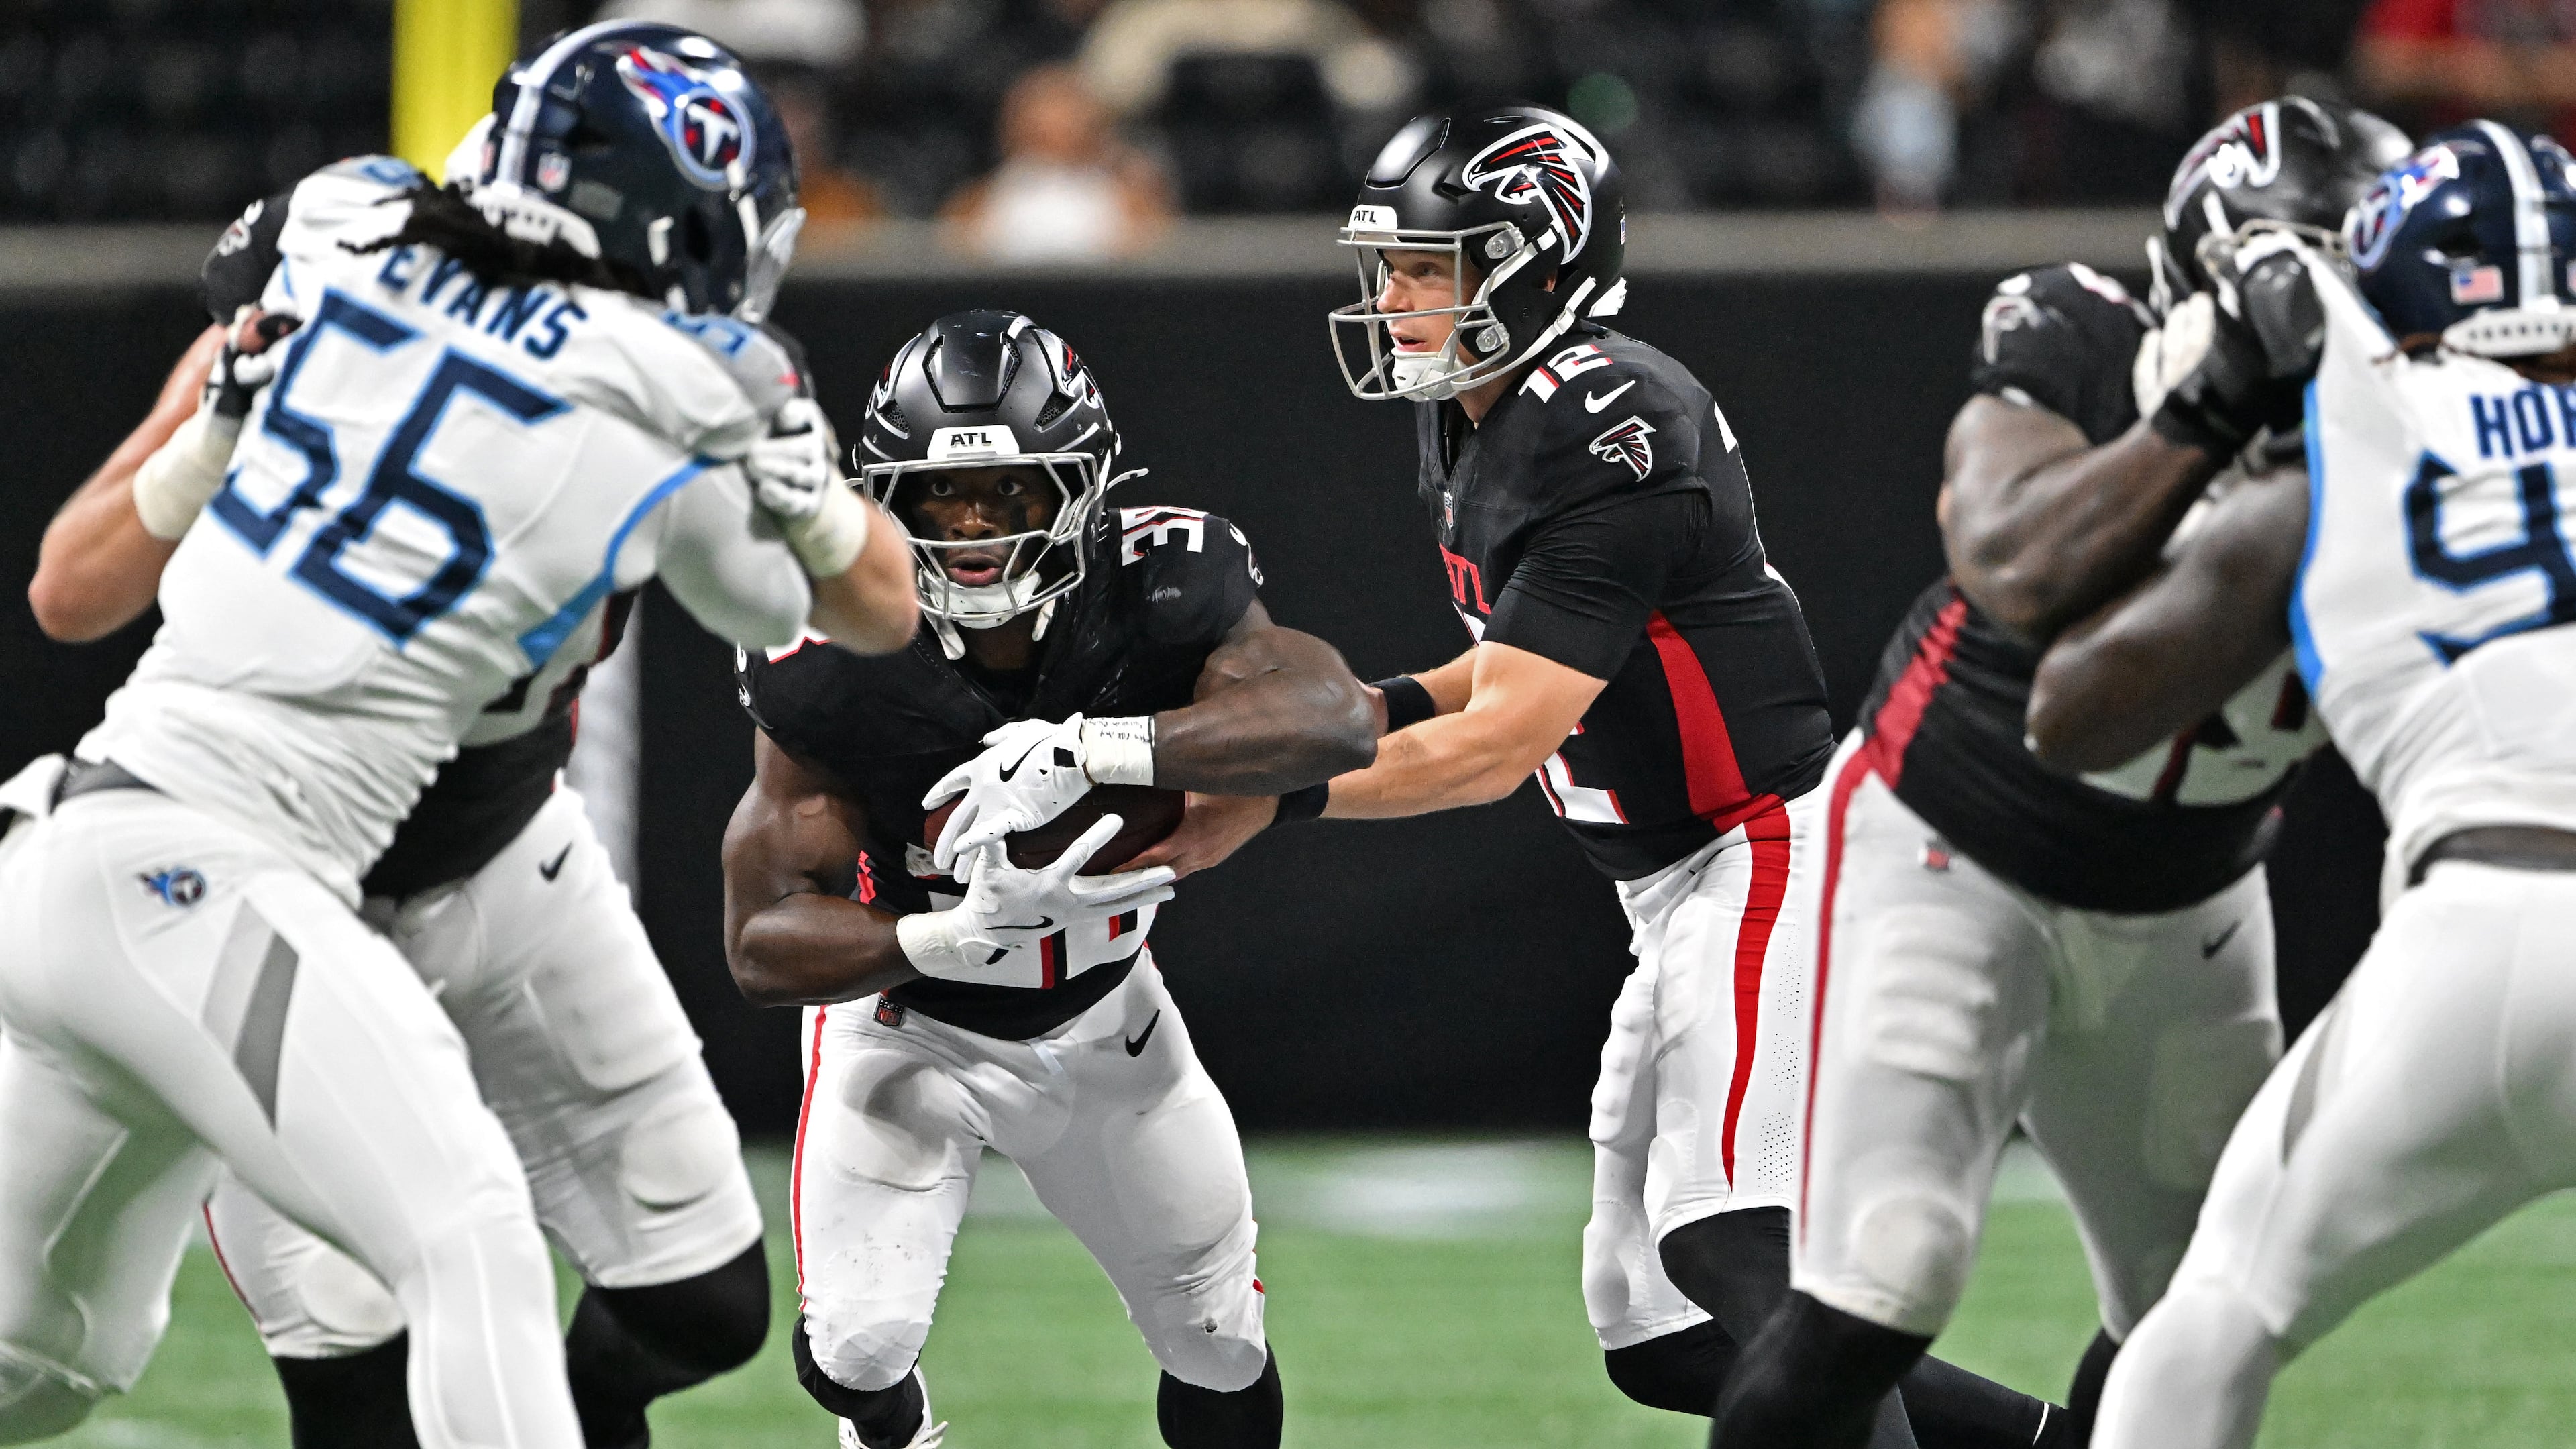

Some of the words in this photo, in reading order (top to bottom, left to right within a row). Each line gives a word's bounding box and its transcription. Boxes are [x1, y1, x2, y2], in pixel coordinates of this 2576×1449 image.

[1354, 210, 1377, 223] ATL
[376, 244, 588, 360] EVANS
[1517, 344, 1614, 404] 12
[207, 286, 576, 650] 56
[950, 432, 992, 447] ATL
